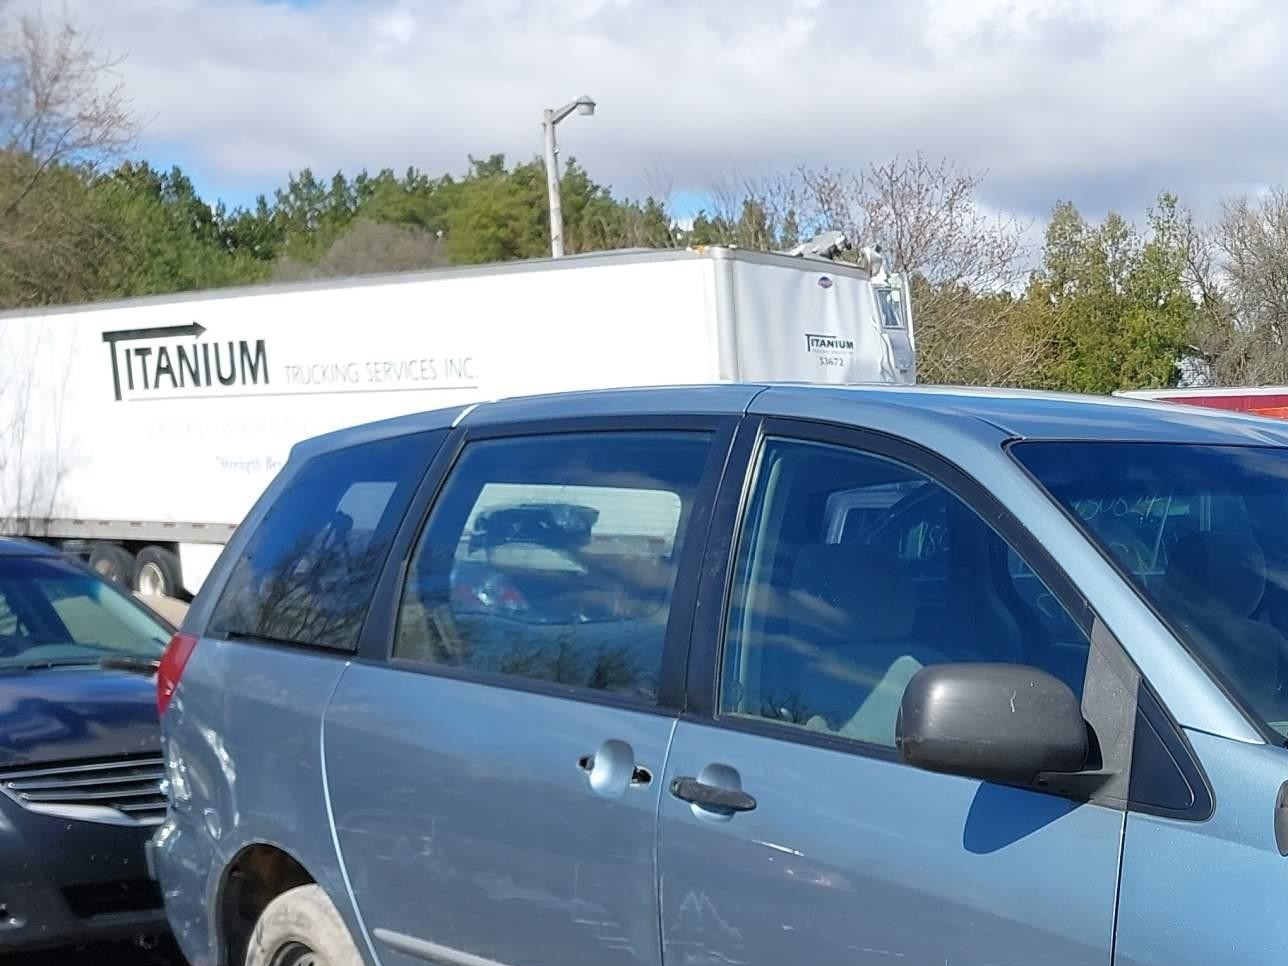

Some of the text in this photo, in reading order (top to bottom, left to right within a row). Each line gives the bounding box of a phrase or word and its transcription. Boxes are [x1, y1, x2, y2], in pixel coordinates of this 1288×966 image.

[102, 321, 269, 401] TITANIUM
[284, 363, 359, 385] TRUCKING
[365, 358, 438, 383] SERVICES
[805, 333, 854, 352] TITANIUM
